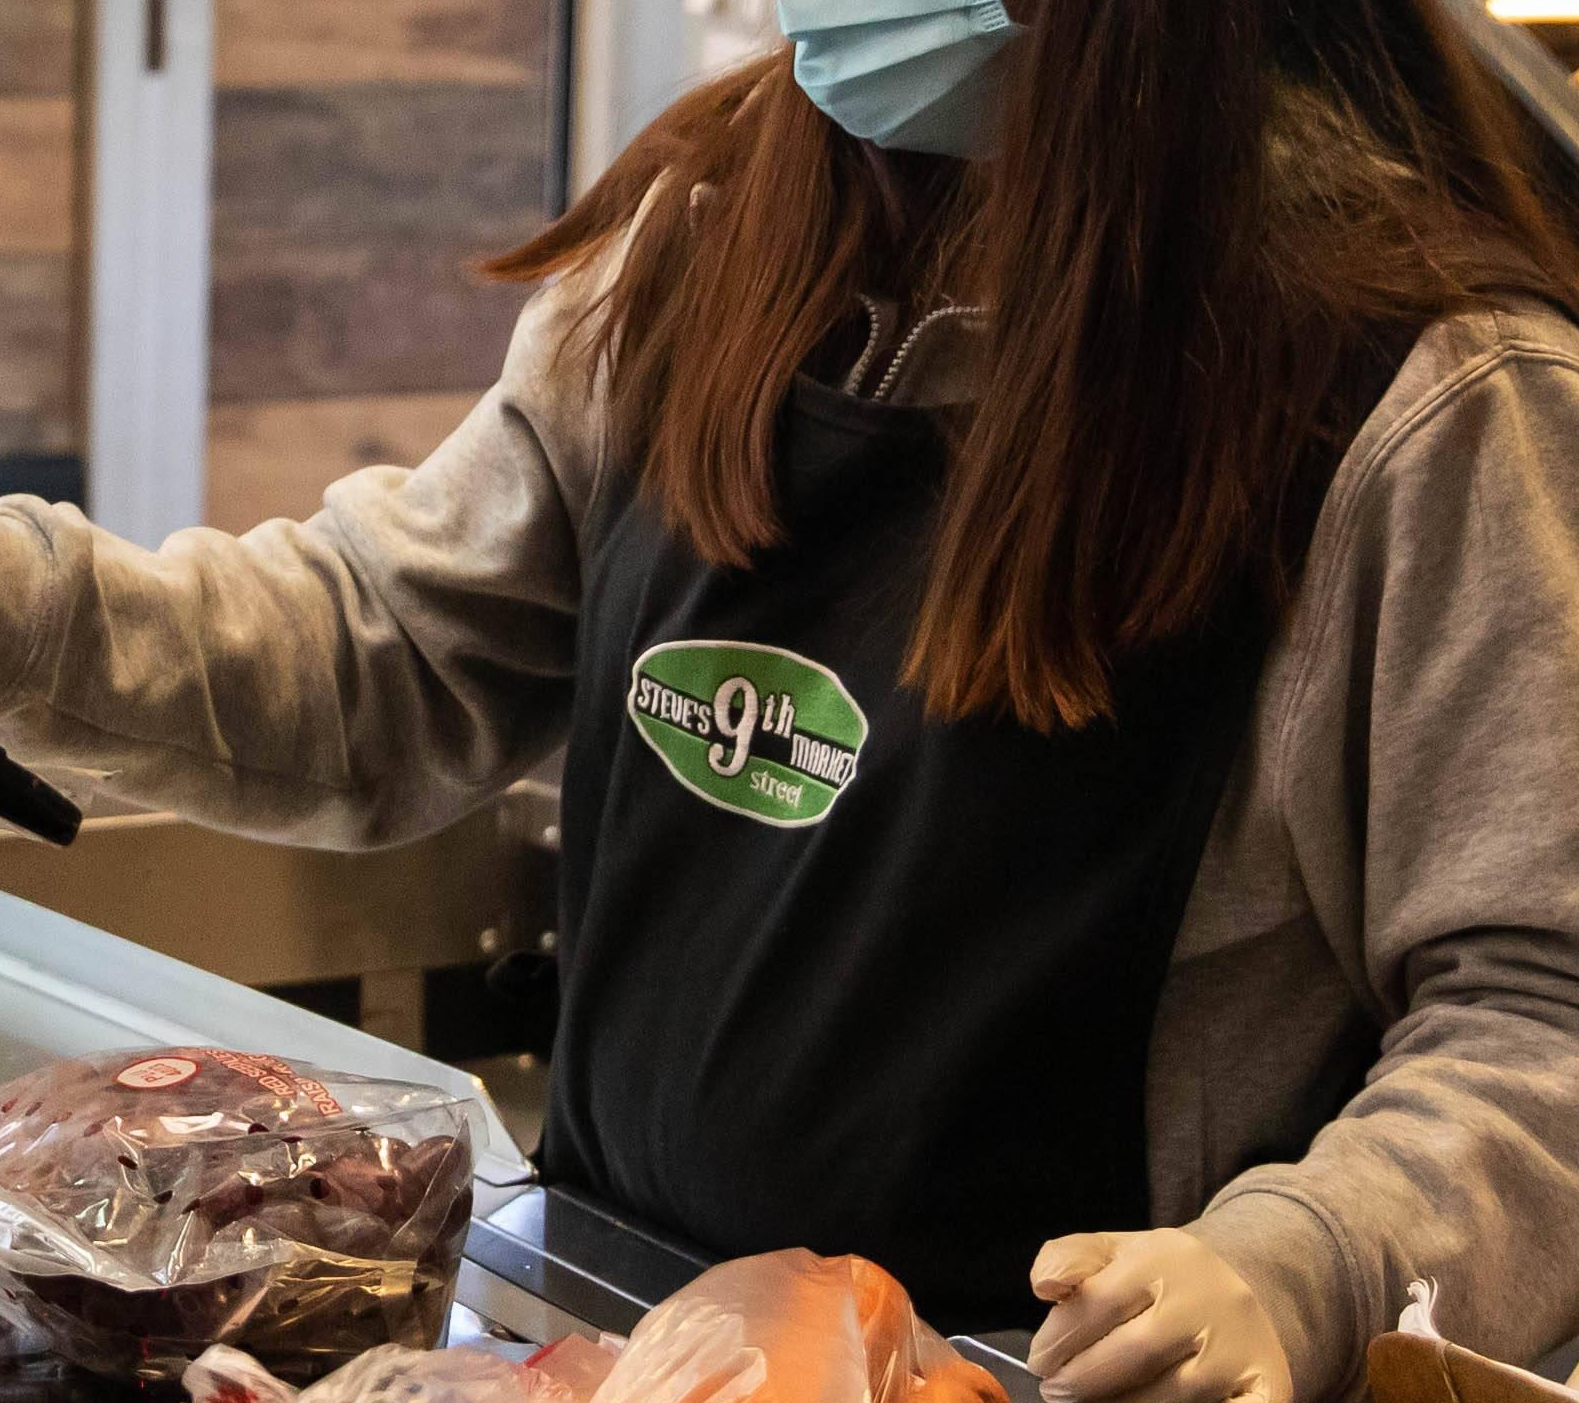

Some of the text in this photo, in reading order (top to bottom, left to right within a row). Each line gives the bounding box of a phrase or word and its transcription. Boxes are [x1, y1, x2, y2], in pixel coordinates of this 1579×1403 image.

[636, 676, 712, 735] STEVE'S
[790, 732, 856, 786] MARKET
[749, 769, 804, 808] street
